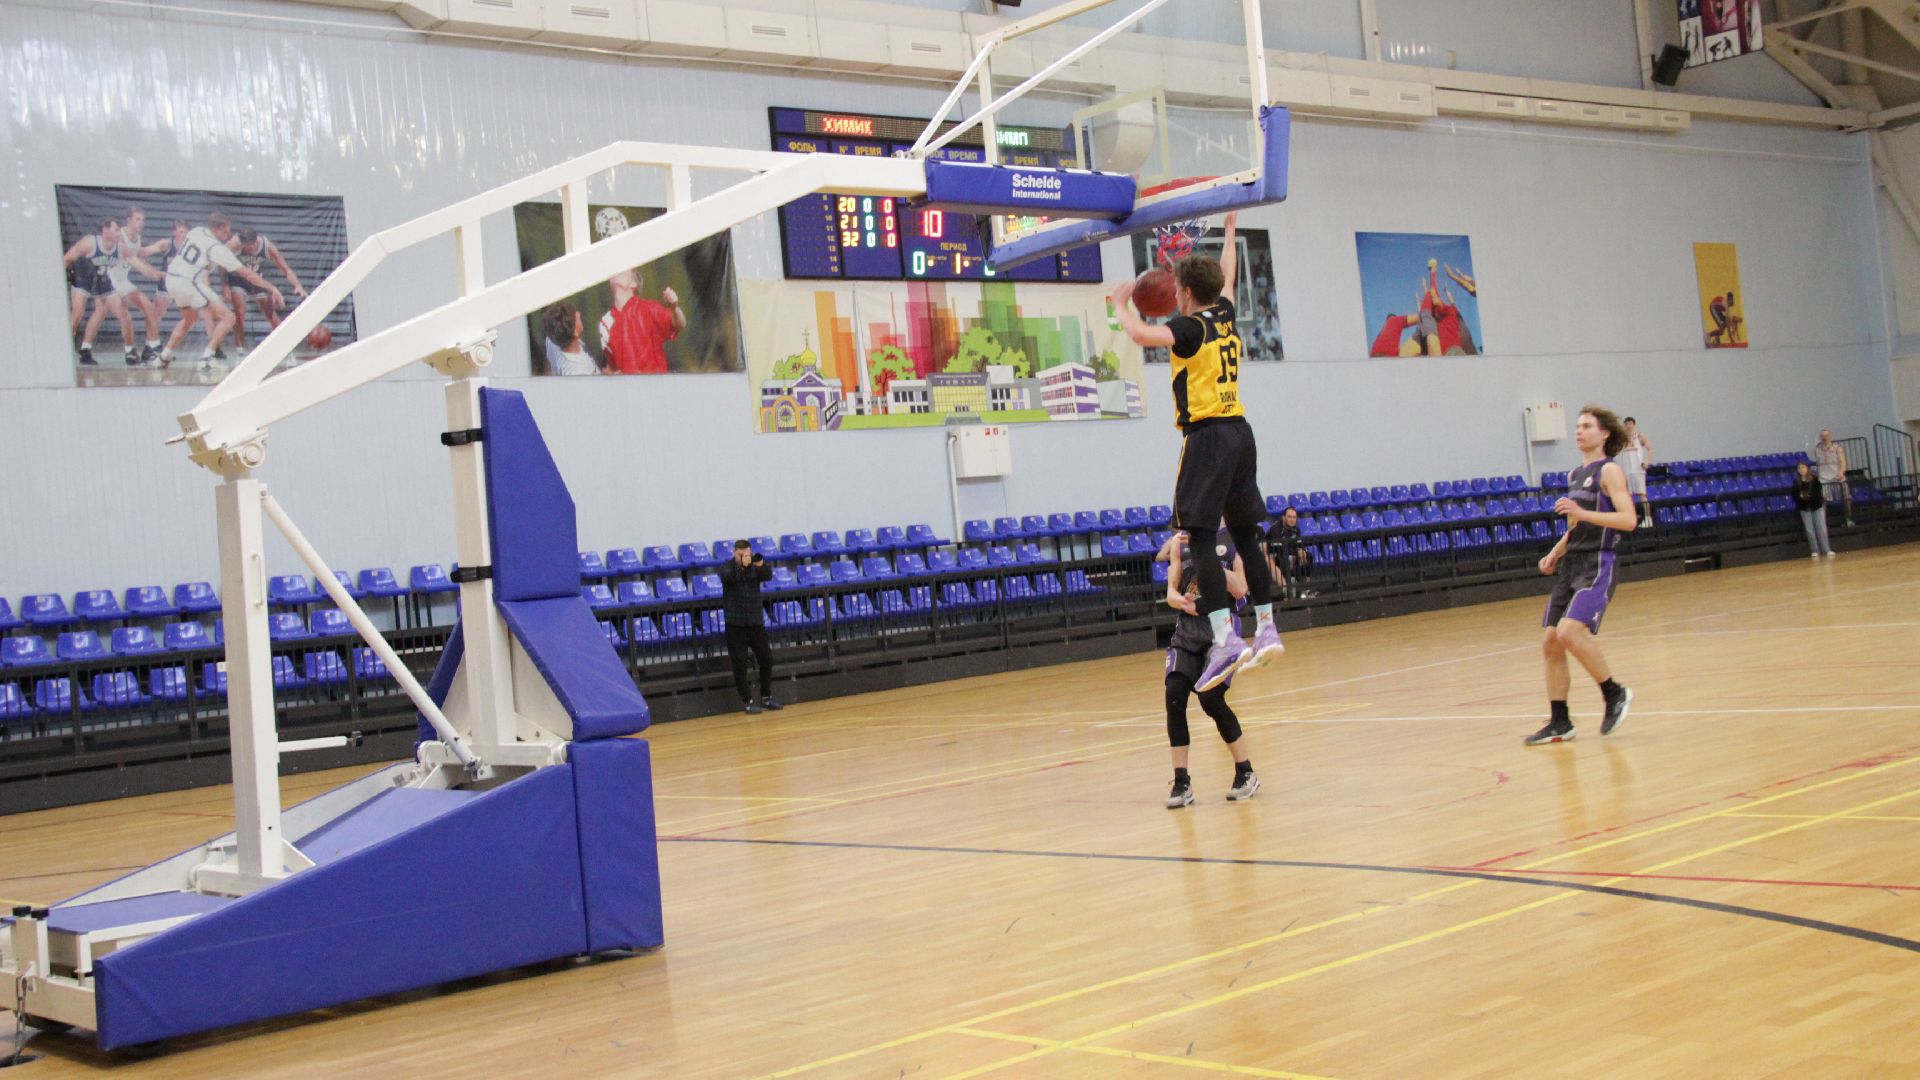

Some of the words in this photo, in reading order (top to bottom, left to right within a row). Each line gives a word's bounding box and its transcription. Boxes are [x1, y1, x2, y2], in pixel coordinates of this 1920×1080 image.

[823, 117, 872, 135] ХИМИК
[788, 142, 816, 152] ФОЛЫ
[855, 146, 881, 156] ВРЕМЯ
[948, 151, 977, 160] ВРЕМЯ
[1012, 174, 1062, 189] Schelde
[1012, 189, 1061, 201] International
[839, 197, 856, 212] 20
[863, 198, 872, 213] 0
[884, 199, 892, 213] 0
[840, 214, 858, 229] 21
[865, 215, 874, 230] 0
[885, 216, 894, 230] 0
[924, 210, 942, 237] 10
[842, 231, 859, 247] 32
[867, 232, 876, 247] 0
[887, 233, 896, 247] 0
[940, 242, 967, 252] ПЕРИОД
[179, 238, 201, 265] 10
[912, 251, 925, 275] 0
